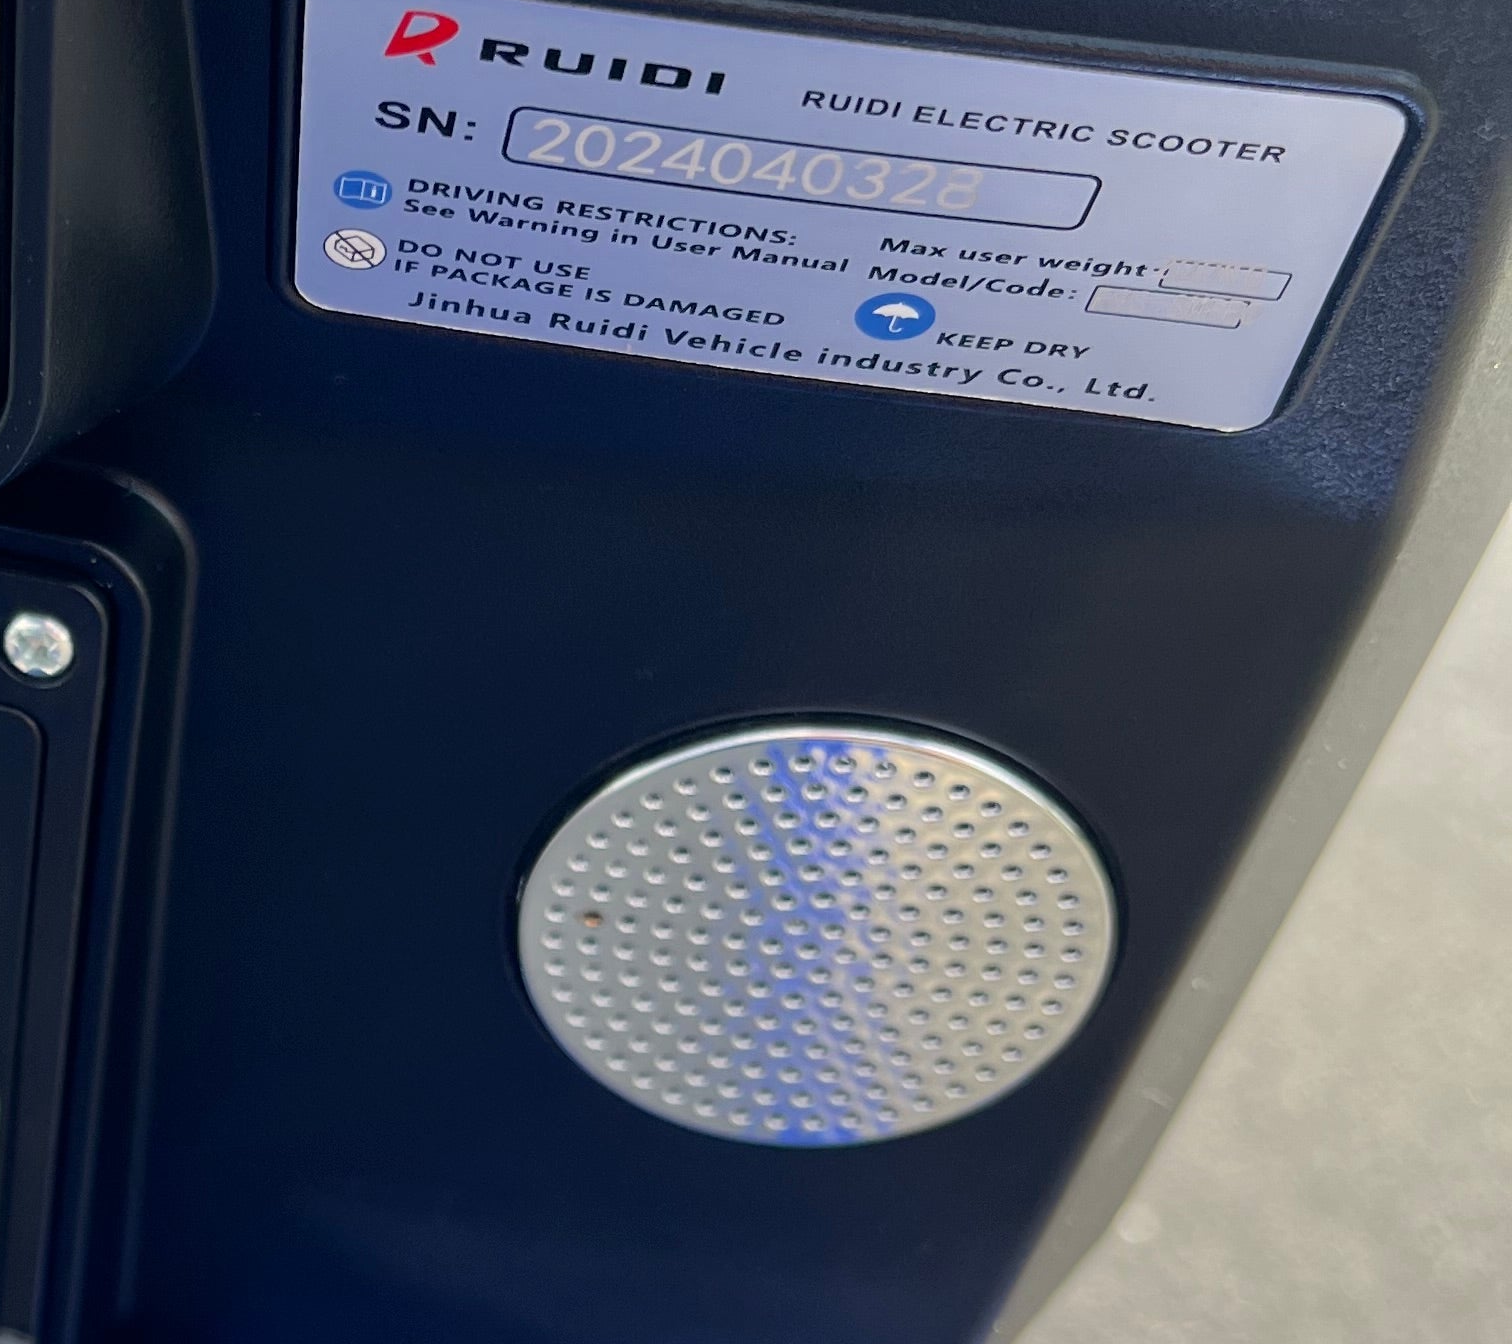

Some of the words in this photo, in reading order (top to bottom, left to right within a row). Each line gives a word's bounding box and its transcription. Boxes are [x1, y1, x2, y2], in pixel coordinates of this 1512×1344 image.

[479, 38, 726, 96] RUIDI
[375, 101, 476, 141] SN:
[527, 118, 984, 210] 2024040328
[801, 90, 901, 118] RUIDI
[912, 105, 1096, 143] ELECTRIC
[1107, 129, 1286, 164] SCOOTER
[403, 198, 455, 219] See
[468, 208, 599, 243] Warning
[610, 228, 638, 246] in
[652, 234, 721, 256] User
[732, 246, 849, 272] Manual
[407, 178, 544, 211] DRIVING
[556, 201, 796, 245] RESTRICTIONS:
[397, 239, 443, 258] DO
[455, 248, 522, 269] NOT
[533, 259, 591, 281] USE
[868, 266, 1077, 300] Model/Code:
[879, 237, 948, 258] Max
[958, 248, 1028, 265] user
[394, 259, 419, 273] IF
[431, 264, 575, 298] PACKAGE
[585, 287, 612, 303] IS
[623, 293, 785, 326] DAMAGED
[408, 291, 532, 325] Jinhua
[548, 311, 648, 342] Ruidi
[664, 327, 803, 362] Vehicle
[817, 348, 983, 385] industry
[997, 367, 1065, 395] Co.,
[1085, 378, 1156, 403] Ltd.
[935, 332, 1014, 351] KEEP
[1024, 341, 1091, 359] DRY
